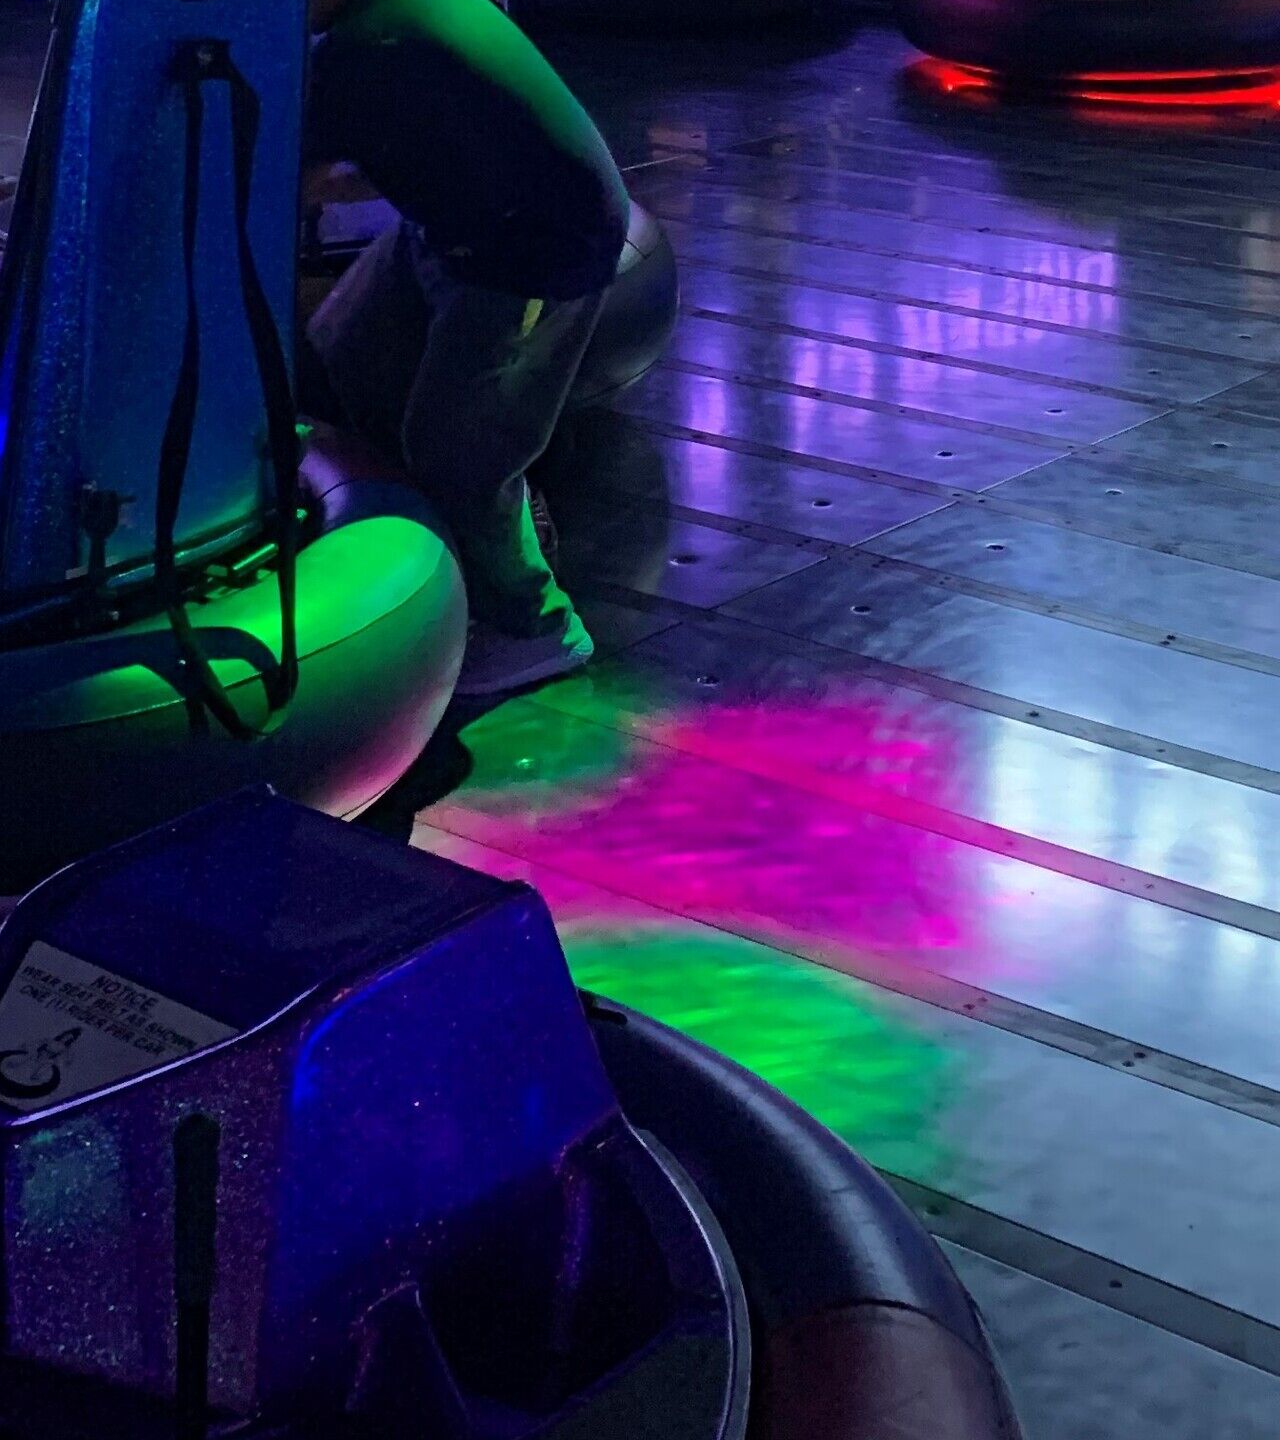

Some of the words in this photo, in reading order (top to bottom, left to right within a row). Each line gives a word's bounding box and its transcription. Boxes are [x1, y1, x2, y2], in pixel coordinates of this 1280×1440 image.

[20, 984, 51, 1003] ONE
[22, 966, 61, 986] WEAR
[59, 982, 94, 1001] SEAT
[91, 975, 159, 1011] NOTICE
